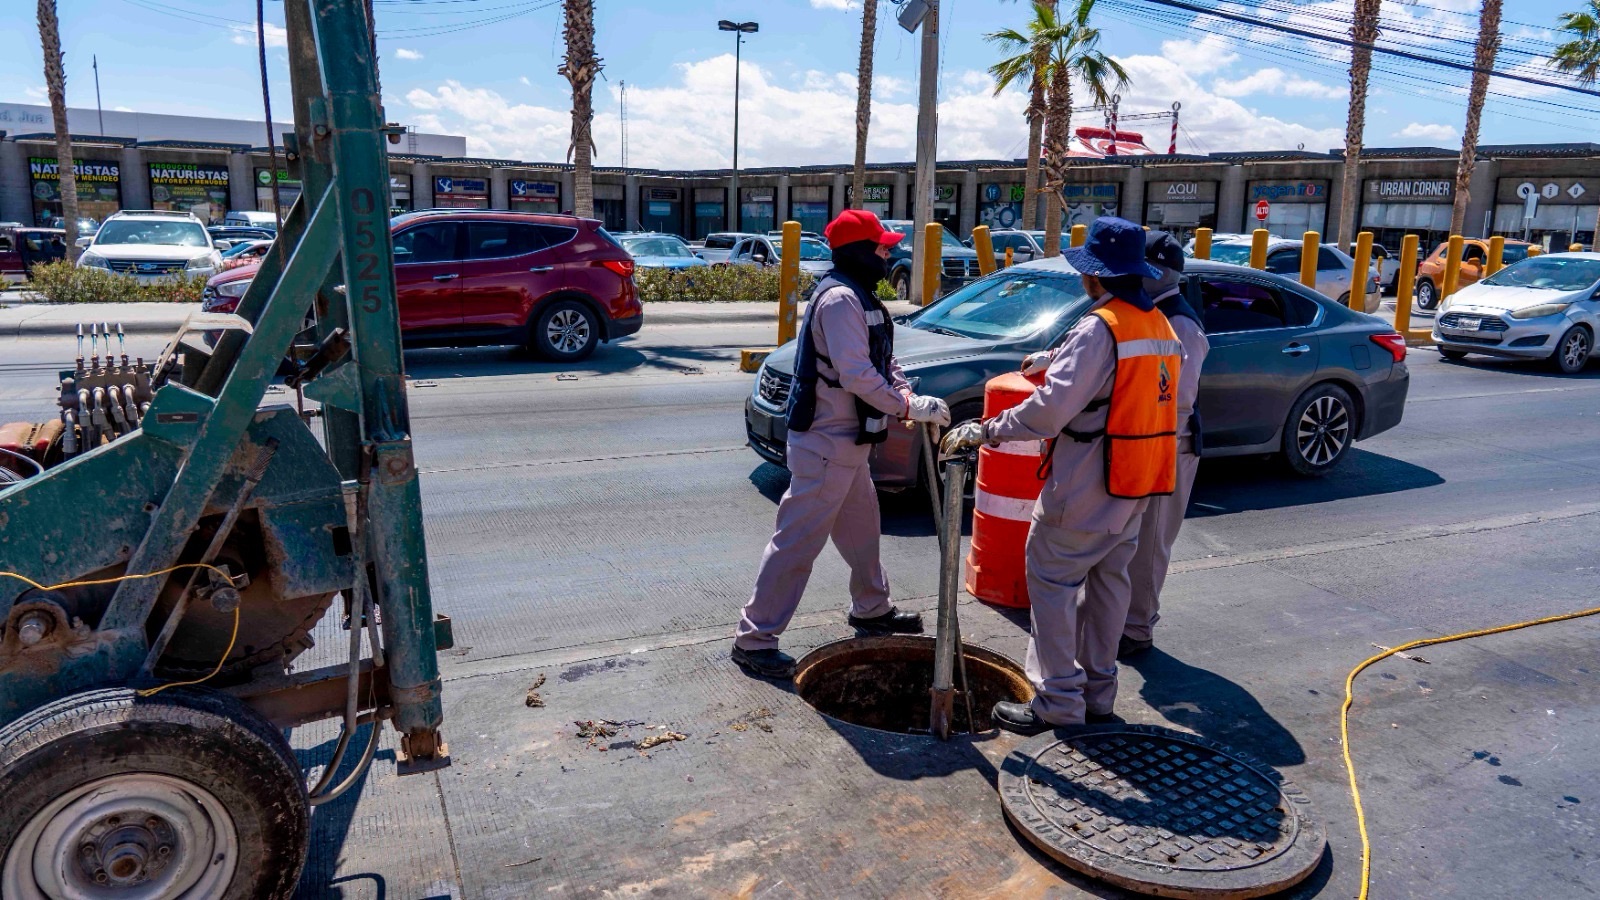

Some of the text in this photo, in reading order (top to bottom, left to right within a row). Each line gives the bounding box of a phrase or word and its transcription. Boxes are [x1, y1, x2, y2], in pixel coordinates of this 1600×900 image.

[31, 163, 119, 176] NATRISTAS
[150, 169, 229, 181] NATURISTAS
[1167, 183, 1198, 195] AQUI
[1380, 181, 1412, 196] URBAN
[1412, 181, 1450, 196] CORNER
[1256, 206, 1269, 215] ALTO
